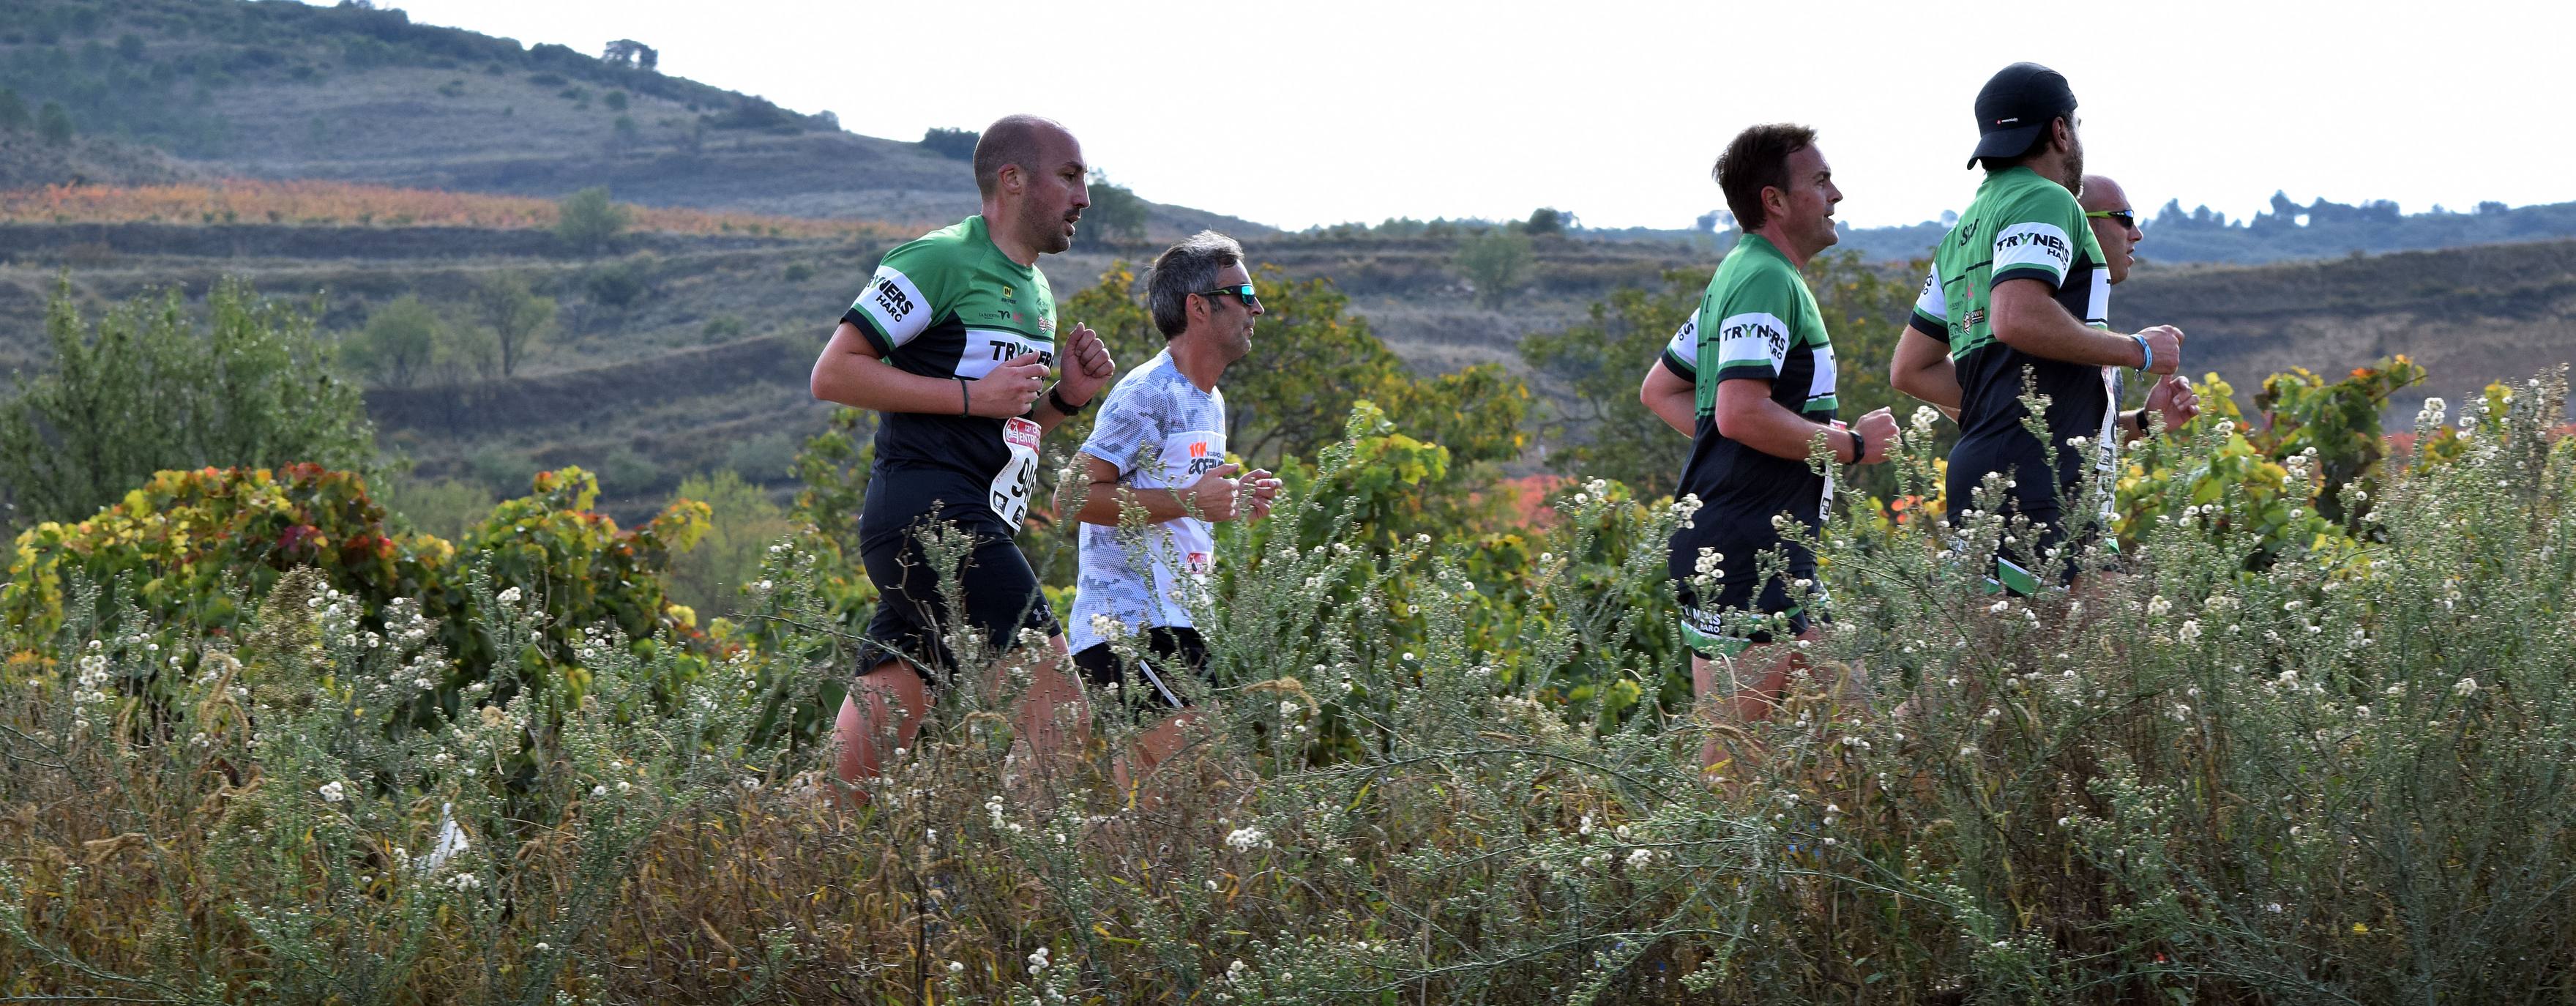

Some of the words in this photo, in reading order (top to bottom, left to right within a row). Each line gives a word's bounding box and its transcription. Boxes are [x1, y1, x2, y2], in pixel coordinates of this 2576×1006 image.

[1997, 232, 2069, 263] TRYNERS
[1004, 288, 1012, 296] IN
[876, 294, 902, 322] HARO
[1723, 324, 1785, 351] TRYNRS
[990, 340, 1054, 370] TRYER
